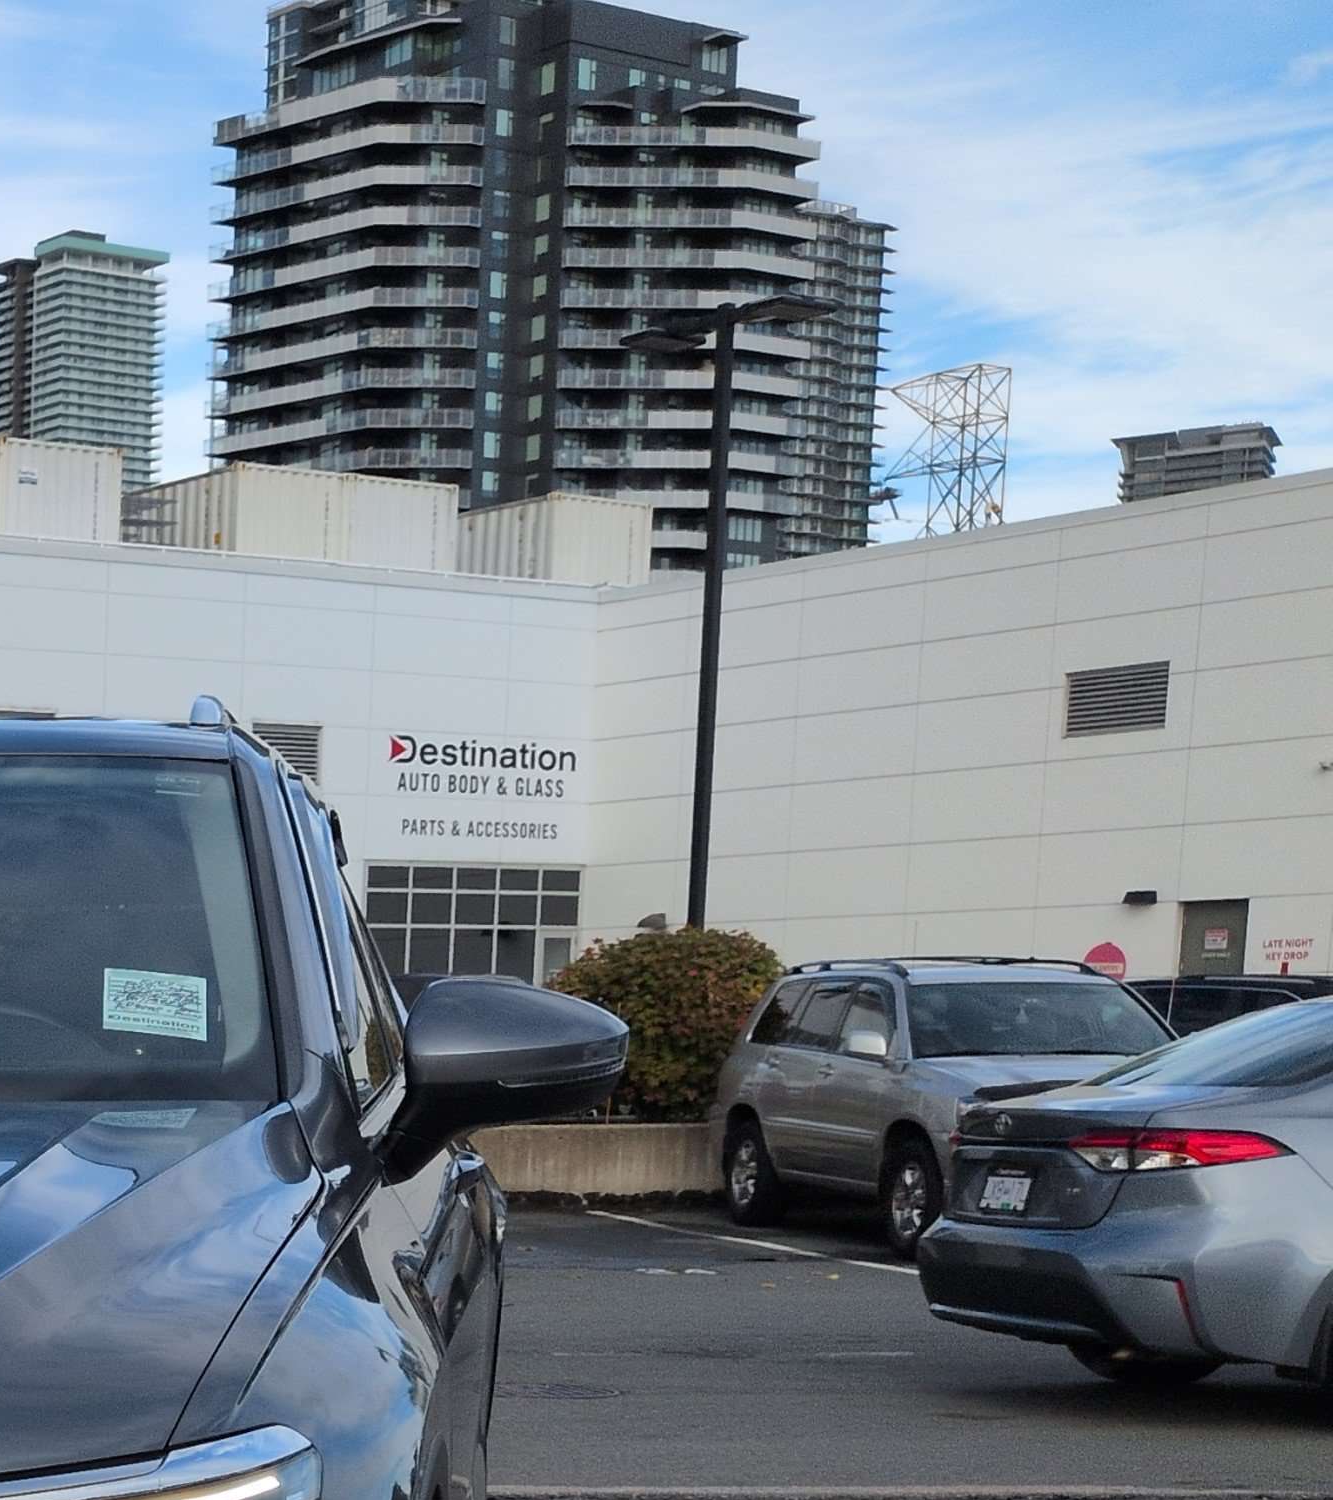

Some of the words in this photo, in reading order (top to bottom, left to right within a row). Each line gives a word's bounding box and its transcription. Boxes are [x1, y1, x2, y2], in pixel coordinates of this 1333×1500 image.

[389, 735, 577, 772] Destination
[397, 772, 441, 793] AUTO
[448, 774, 490, 795] BODY
[497, 776, 507, 795] &
[515, 777, 564, 798] GLASS
[401, 818, 445, 836] PARTS
[451, 820, 461, 836] &
[466, 821, 558, 840] ACCESSORIES
[1263, 939, 1283, 949] LATE
[1285, 938, 1314, 948] NIGHT
[1265, 951, 1282, 961] KEY
[1284, 951, 1309, 961] DROP
[108, 1014, 200, 1031] Destination
